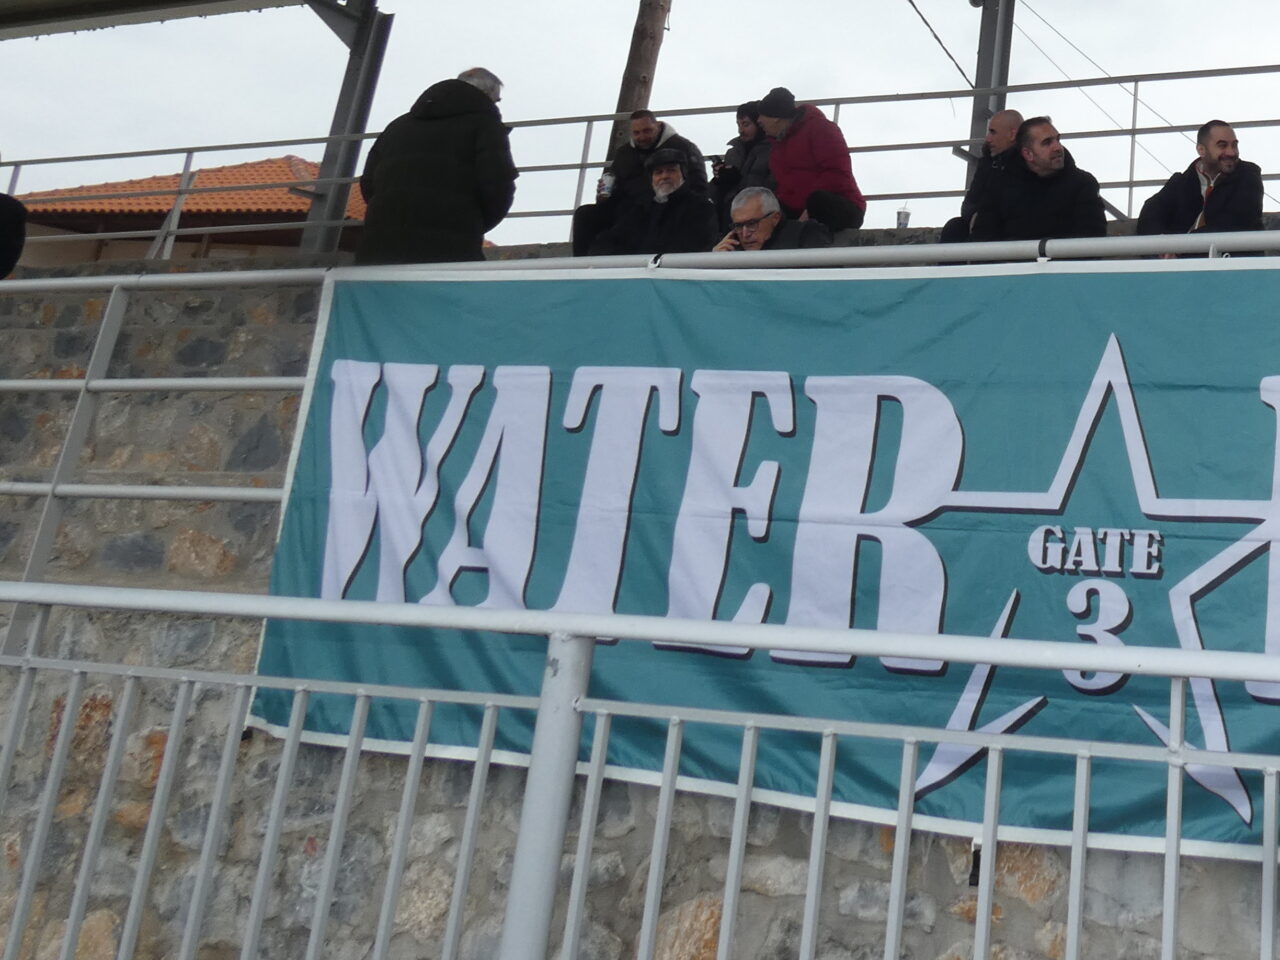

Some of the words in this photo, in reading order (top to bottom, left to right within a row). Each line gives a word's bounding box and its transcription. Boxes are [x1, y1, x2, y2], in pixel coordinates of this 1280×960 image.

[321, 358, 966, 677] WATER
[1027, 524, 1164, 580] GATE
[1062, 578, 1134, 697] 3
